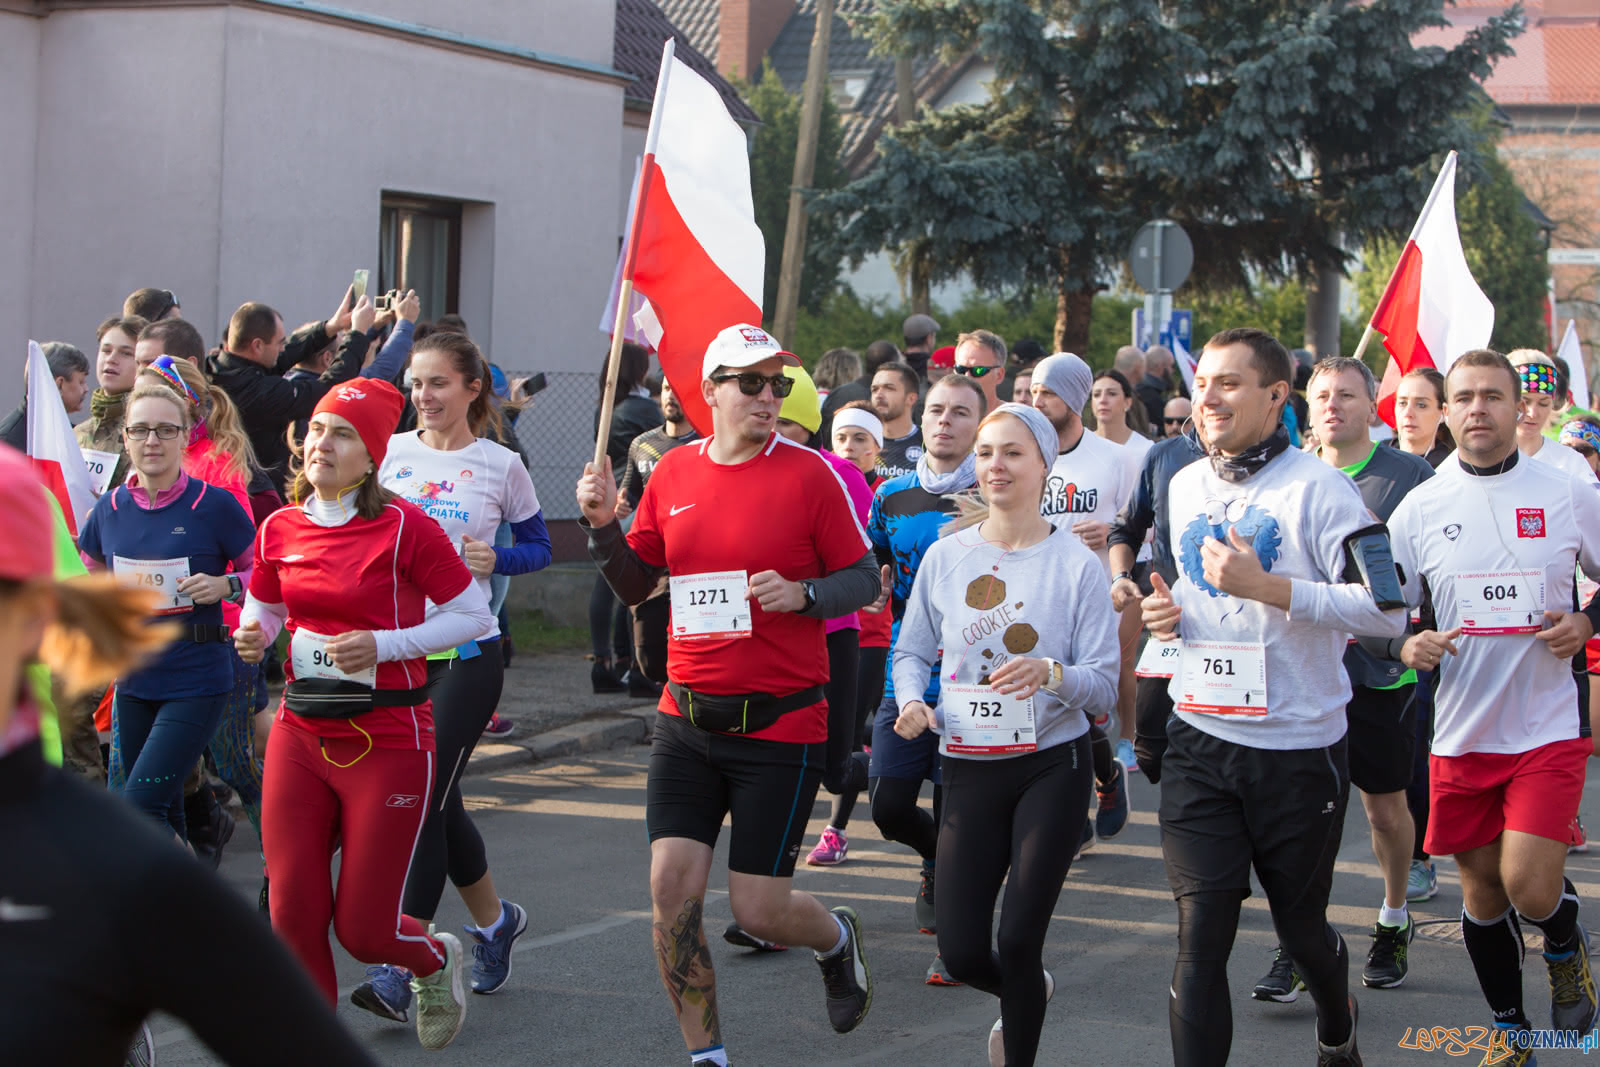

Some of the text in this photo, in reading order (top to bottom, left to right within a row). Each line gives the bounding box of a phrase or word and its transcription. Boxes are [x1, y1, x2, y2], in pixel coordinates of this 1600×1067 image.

[85, 461, 104, 474] 70
[428, 507, 470, 523] PIĄTKĘ
[1518, 508, 1542, 516] POLSKA
[135, 573, 164, 587] 749
[689, 588, 729, 606] 1271
[1483, 585, 1518, 601] 604
[962, 604, 1017, 645] COOKIE
[313, 650, 334, 667] 90
[1162, 648, 1180, 657] 87
[1203, 658, 1236, 676] 761
[968, 701, 1002, 717] 752
